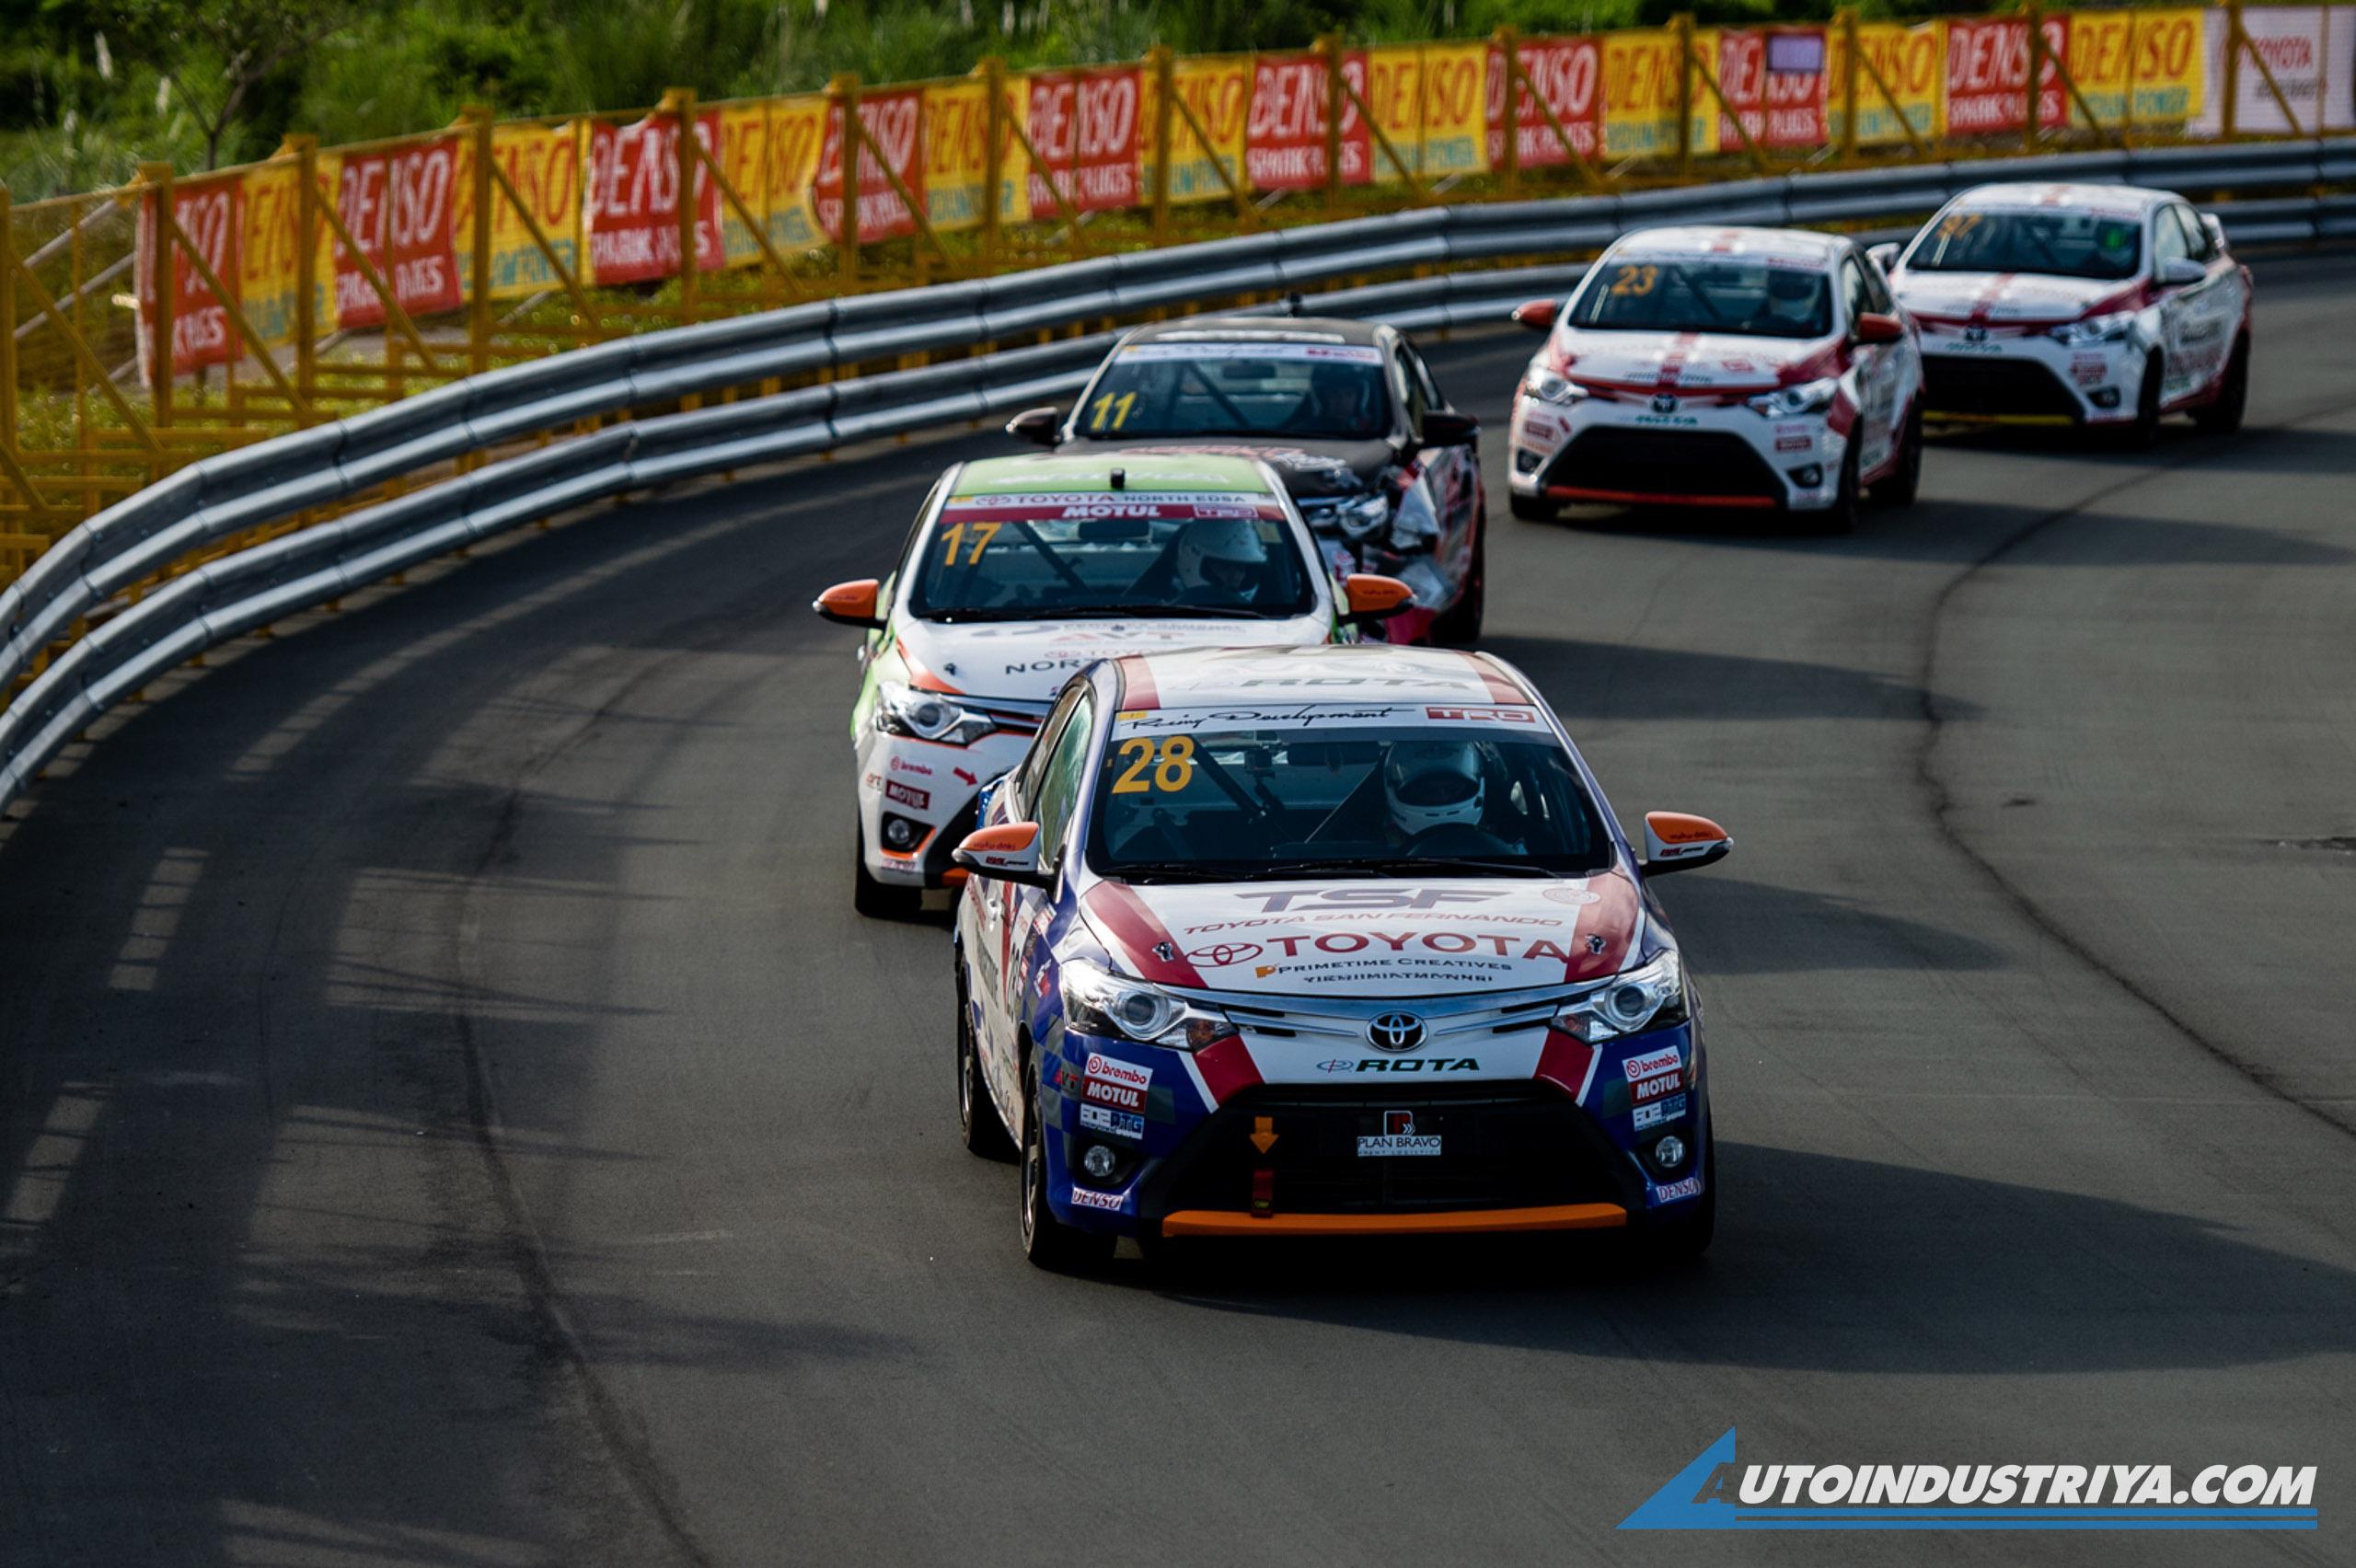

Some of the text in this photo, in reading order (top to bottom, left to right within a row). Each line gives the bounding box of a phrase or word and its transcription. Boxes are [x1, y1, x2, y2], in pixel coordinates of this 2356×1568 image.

[2073, 17, 2194, 85] DENSO
[1611, 265, 1658, 296] 23
[1091, 392, 1137, 431] 11
[1017, 491, 1246, 504] TOYOTA NORTH EDSA
[1062, 505, 1161, 518] MOTUL
[941, 521, 1002, 567] 17
[1428, 708, 1533, 723] TRD
[1112, 735, 1195, 795] 28
[1232, 888, 1514, 914] TSF
[1184, 912, 1563, 935] TOYOTA SAN FERNANDO
[1267, 931, 1568, 964] TOYOTA
[1278, 957, 1512, 974] PRIMETIME CREATIVES
[1102, 1061, 1147, 1085] brembo
[1356, 1058, 1480, 1073] ROTA
[1642, 1054, 1679, 1072] brembo
[1087, 1081, 1139, 1107] MOTUL
[1637, 1073, 1680, 1100] MOTUL
[1357, 1136, 1441, 1148] PLAN BRAVO
[1072, 1187, 1122, 1211] DENSO
